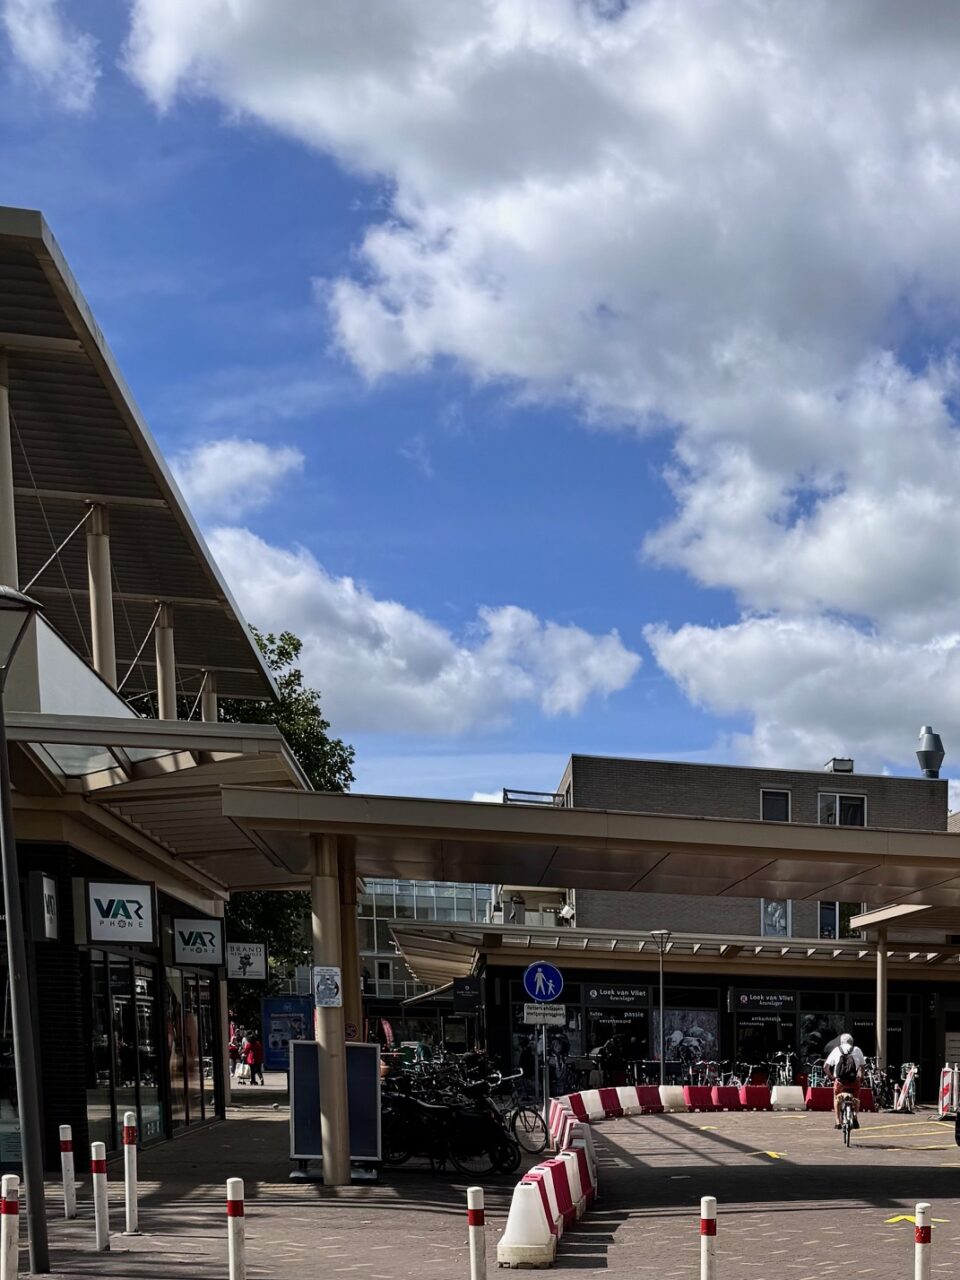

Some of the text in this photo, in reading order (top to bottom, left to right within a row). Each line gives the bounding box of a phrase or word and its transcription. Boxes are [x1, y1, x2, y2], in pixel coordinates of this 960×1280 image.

[93, 898, 143, 920] VAR
[178, 931, 215, 947] VAR
[230, 945, 262, 953] BRAND
